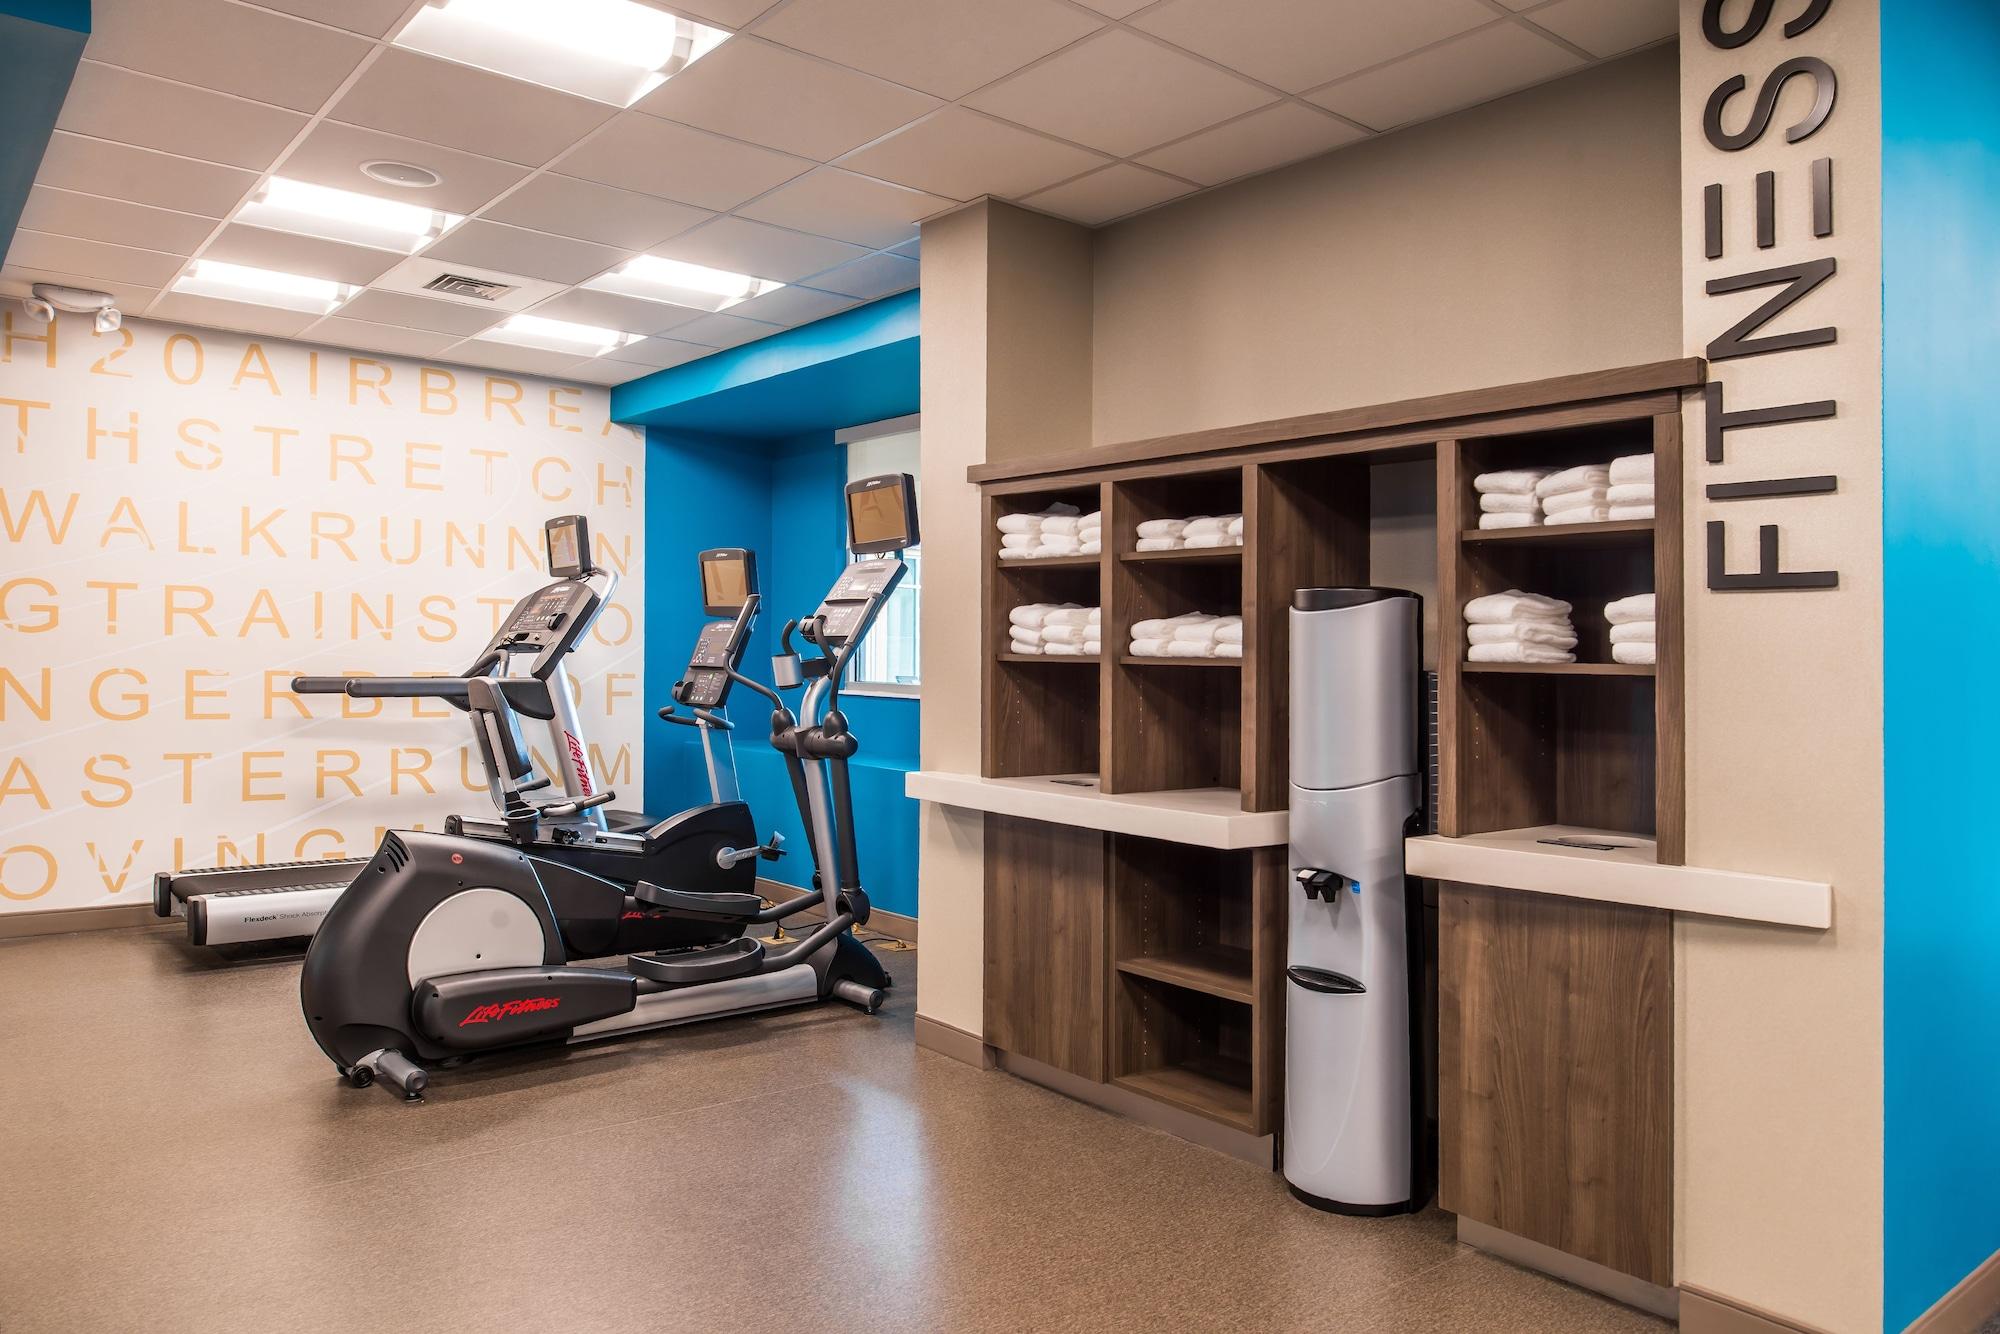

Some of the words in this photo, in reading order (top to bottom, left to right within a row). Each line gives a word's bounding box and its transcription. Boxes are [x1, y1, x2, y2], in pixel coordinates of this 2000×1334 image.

[1702, 0, 1838, 591] FITNESS
[0, 396, 633, 508] THSTRETCH
[0, 487, 632, 577] WALKRUNNN
[0, 576, 633, 648] GTRAINSTO
[244, 915, 277, 923] Flexdeck
